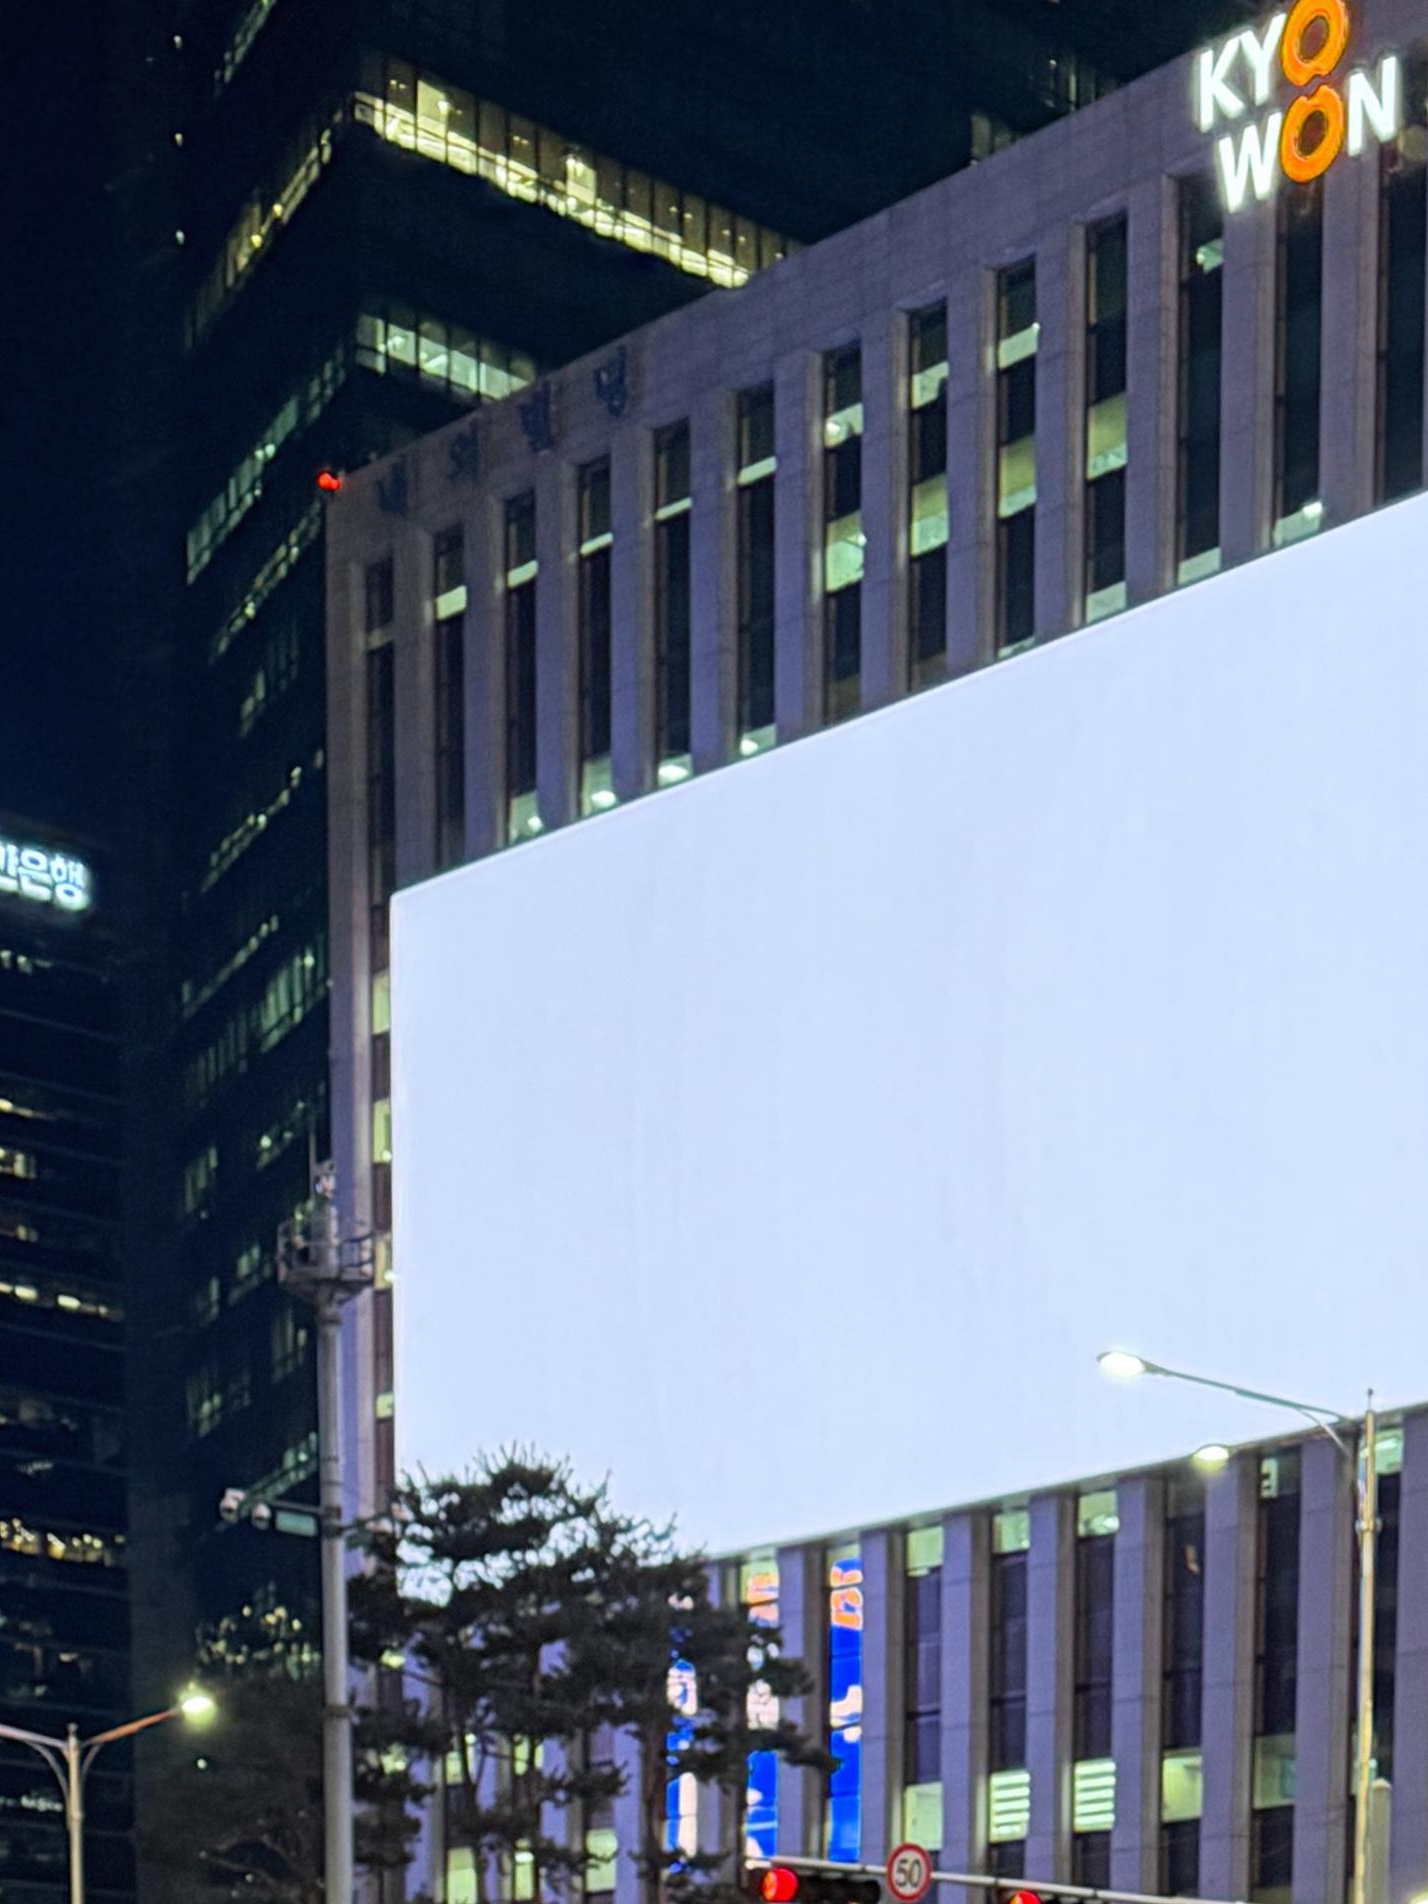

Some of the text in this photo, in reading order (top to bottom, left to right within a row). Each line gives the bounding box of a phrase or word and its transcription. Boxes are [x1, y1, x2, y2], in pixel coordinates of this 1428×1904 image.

[1197, 0, 1351, 132] KYO
[1217, 55, 1399, 214] WON
[895, 1858, 921, 1889] 50
